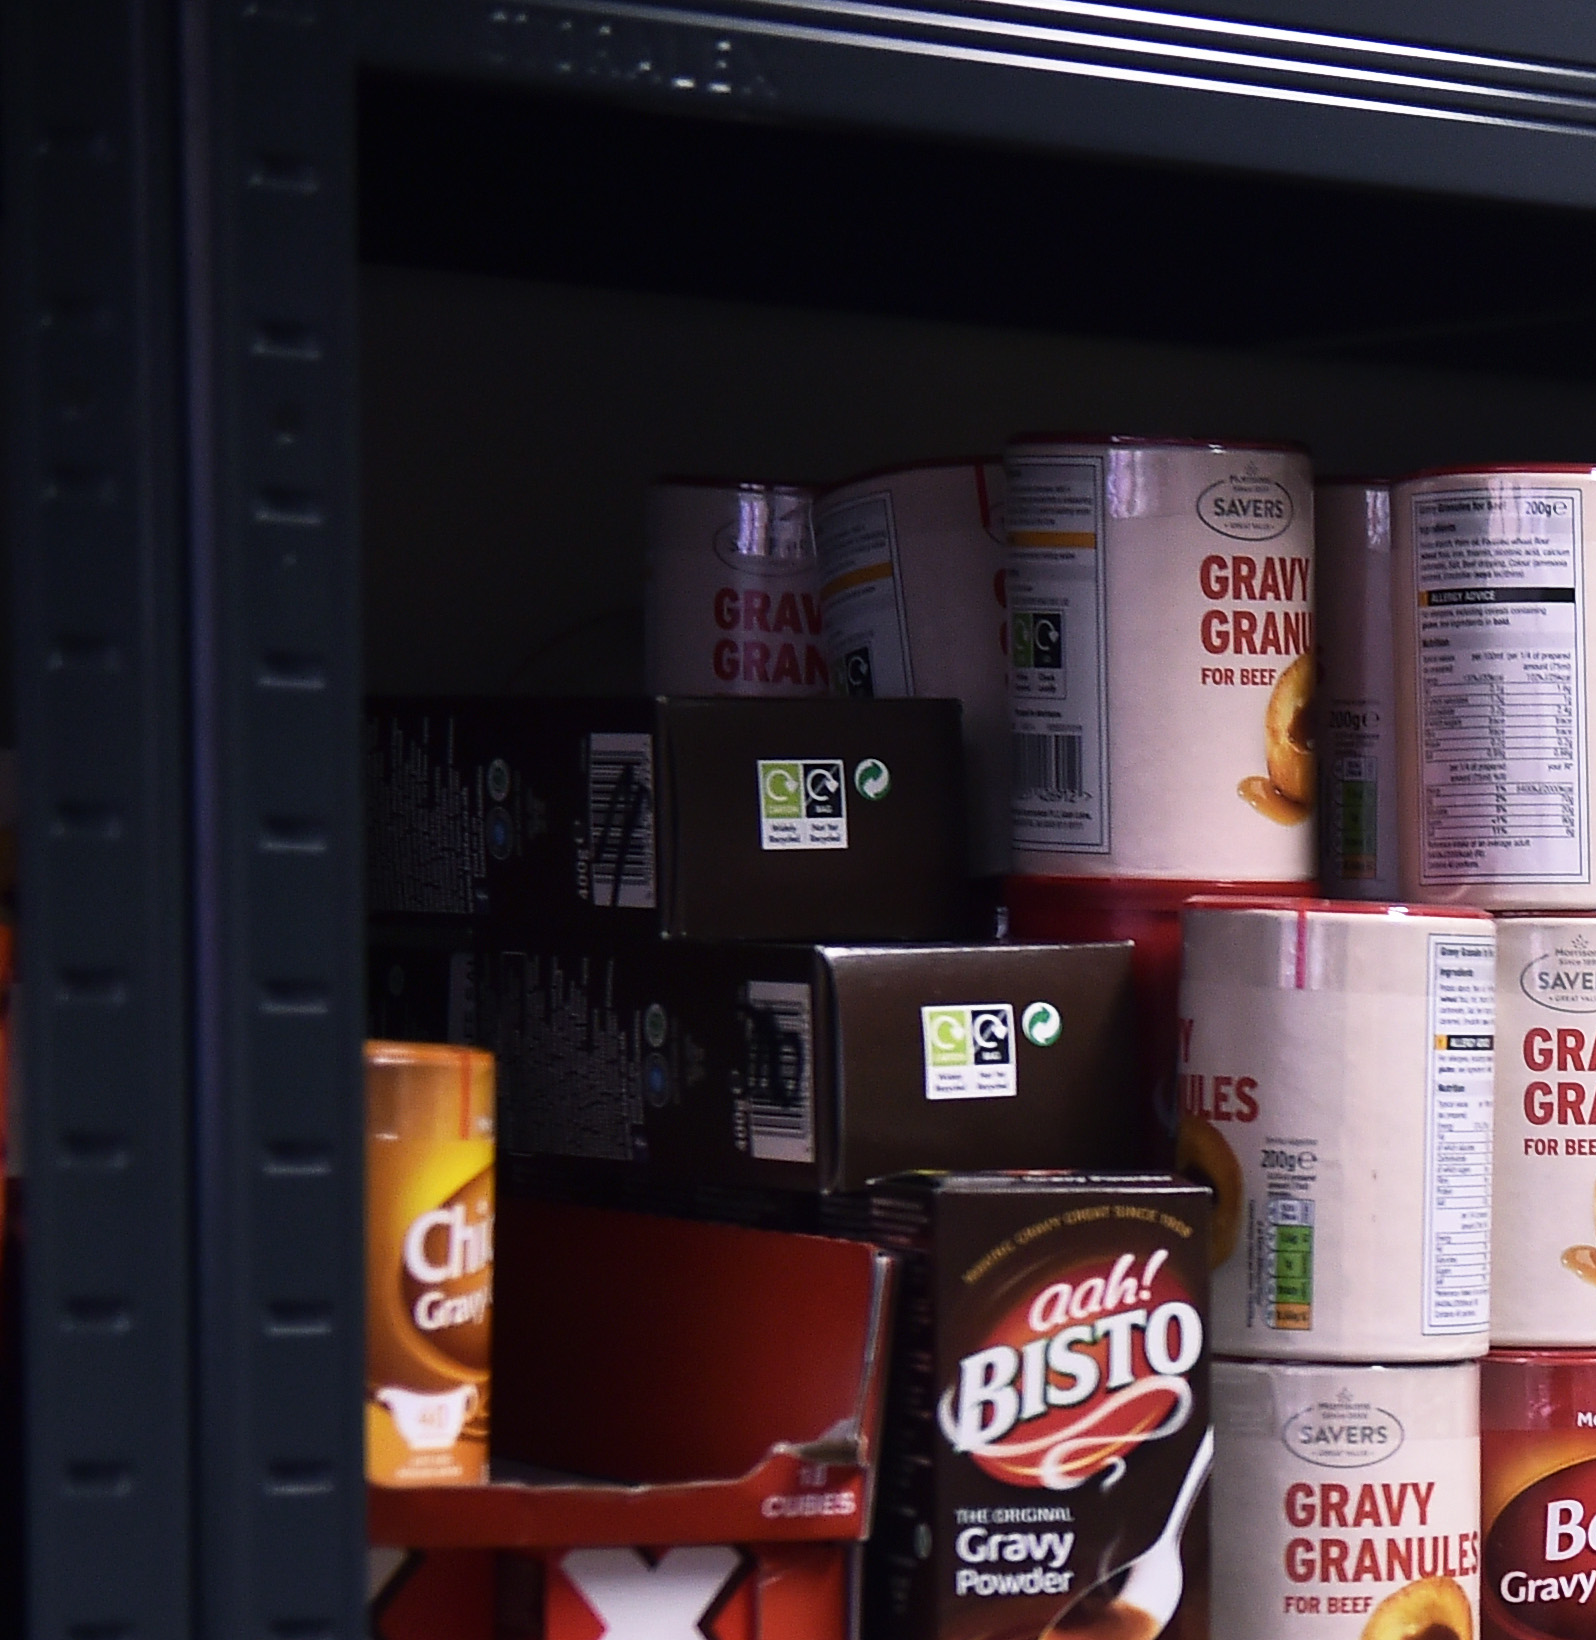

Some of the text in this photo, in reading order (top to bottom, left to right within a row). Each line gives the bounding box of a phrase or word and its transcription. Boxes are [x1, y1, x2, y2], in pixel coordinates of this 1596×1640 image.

[1214, 498, 1283, 518] SAVERS
[1200, 554, 1310, 602] GRAVY
[714, 586, 823, 634] GRAV
[714, 641, 829, 683] GRAN
[1201, 668, 1277, 686] FOR BEEF
[1524, 1138, 1559, 1156] FOR
[957, 1301, 1203, 1453] BISTO
[1300, 1425, 1388, 1445] SAVERS
[761, 1491, 857, 1518] CUBES
[956, 1507, 1076, 1522] THE ORIGINAL
[1284, 1481, 1436, 1528] GRAVY
[955, 1527, 1075, 1568] Gravy
[955, 1567, 1075, 1596] Powder
[1284, 1596, 1374, 1615] FOR BEEF
